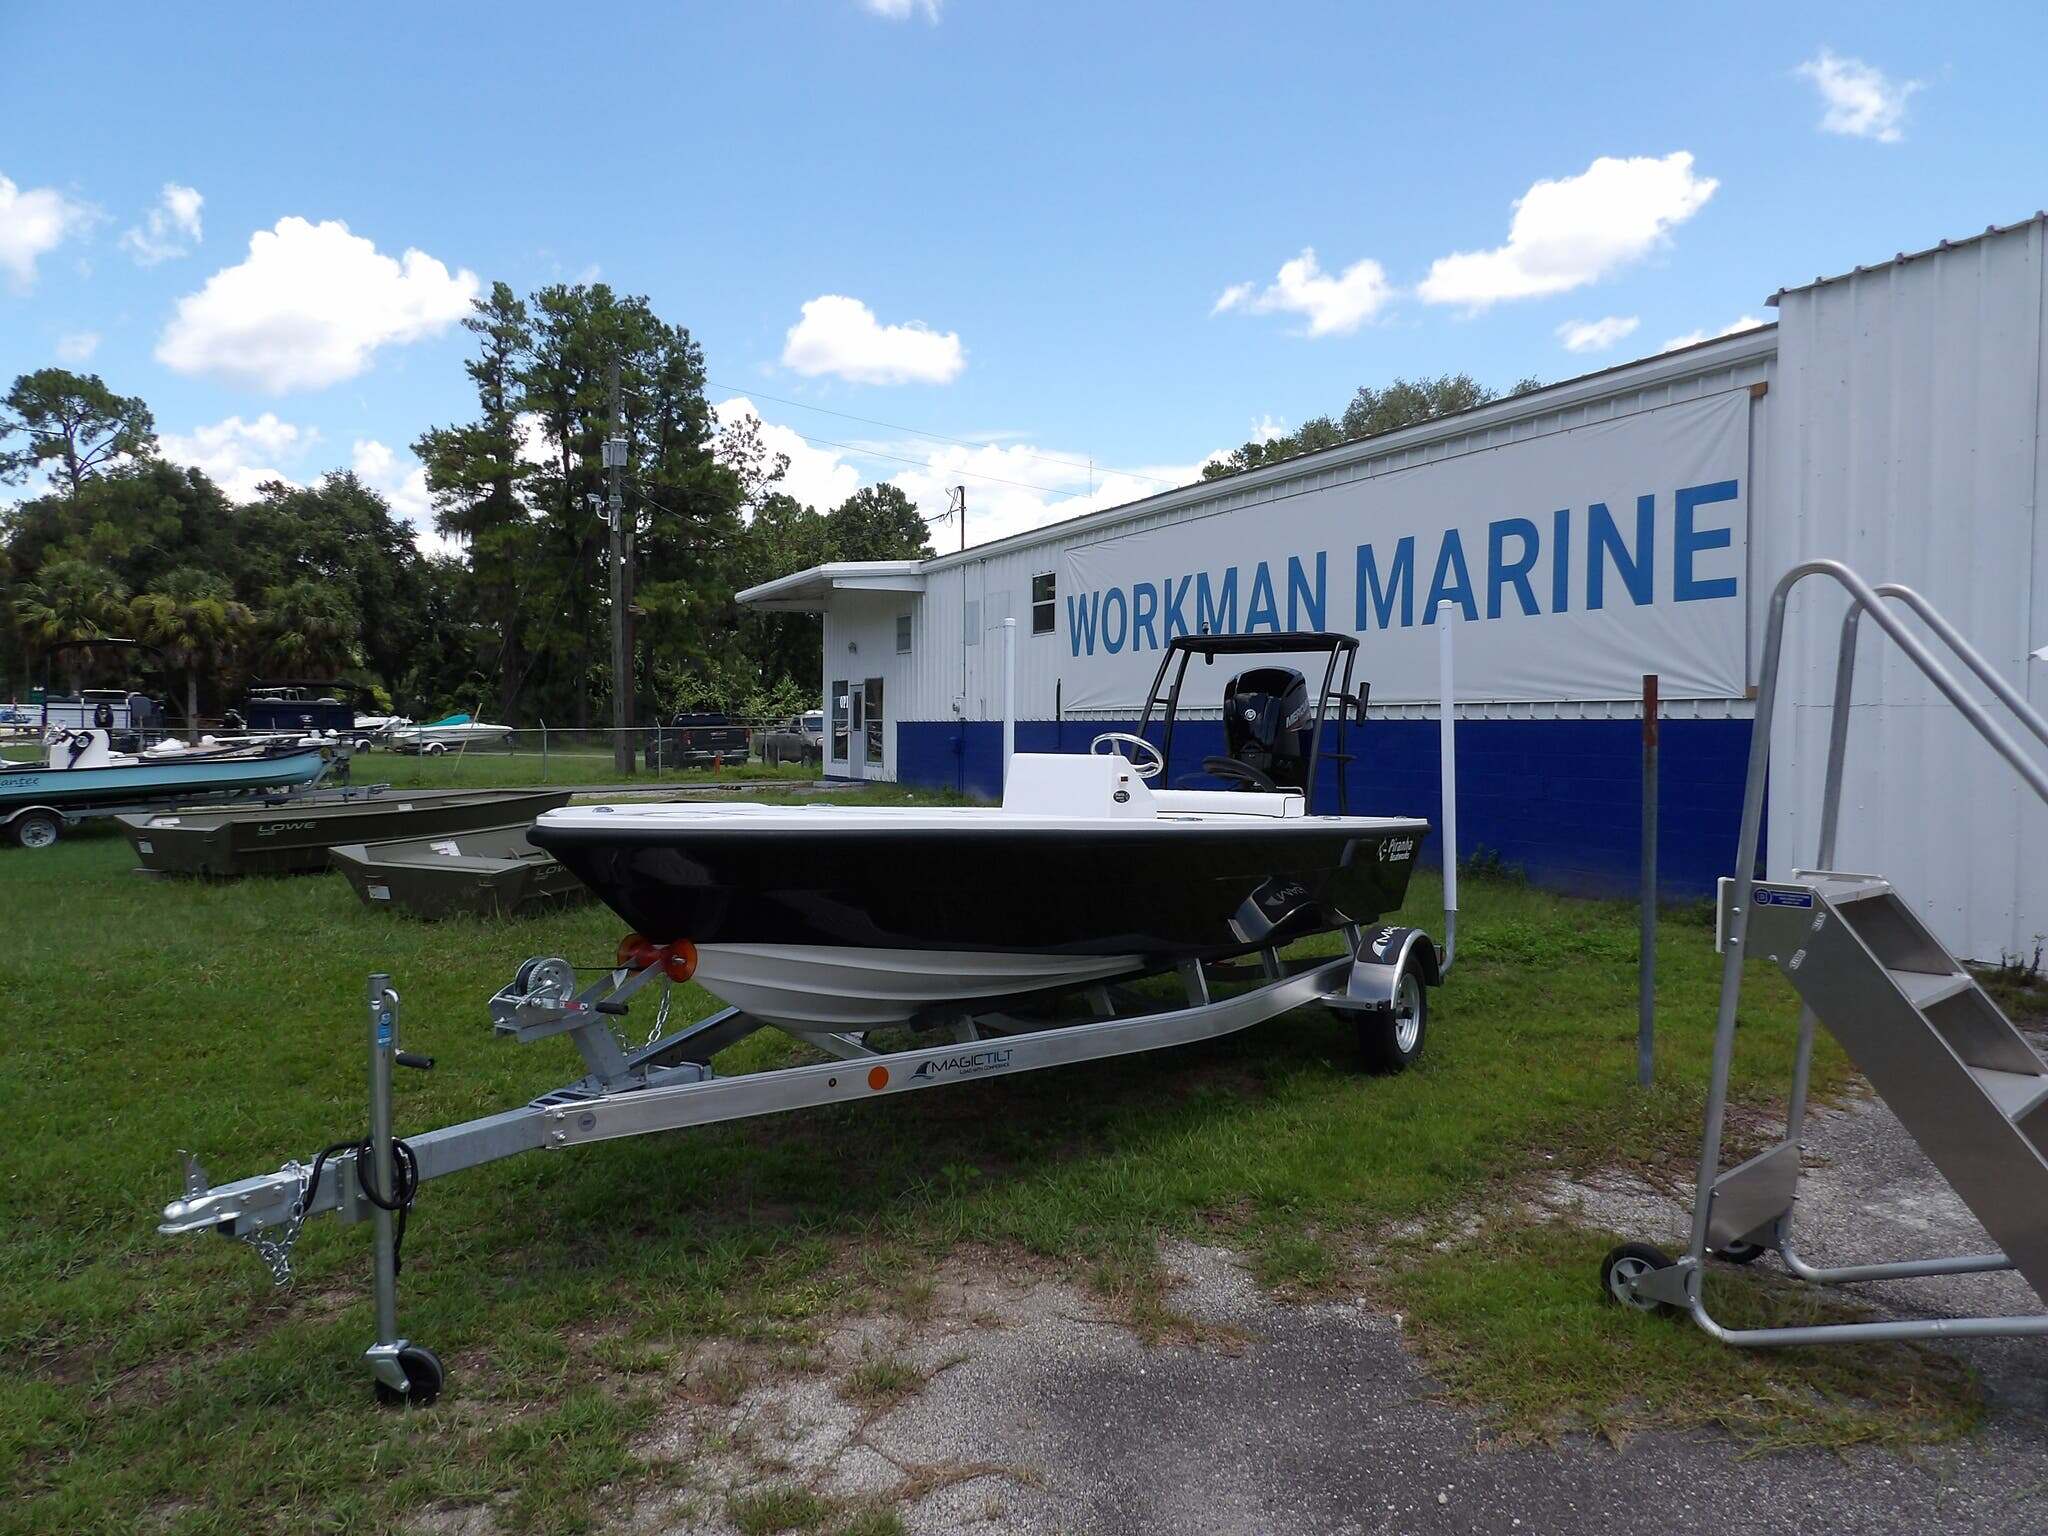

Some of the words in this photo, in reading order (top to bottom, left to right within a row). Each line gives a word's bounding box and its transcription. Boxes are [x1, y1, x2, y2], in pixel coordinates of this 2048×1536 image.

[1067, 551, 1327, 657] WORKMAN
[1355, 479, 1738, 632] MARINE
[258, 821, 318, 832] LOWE
[931, 1049, 1013, 1073] MAGICTILT
